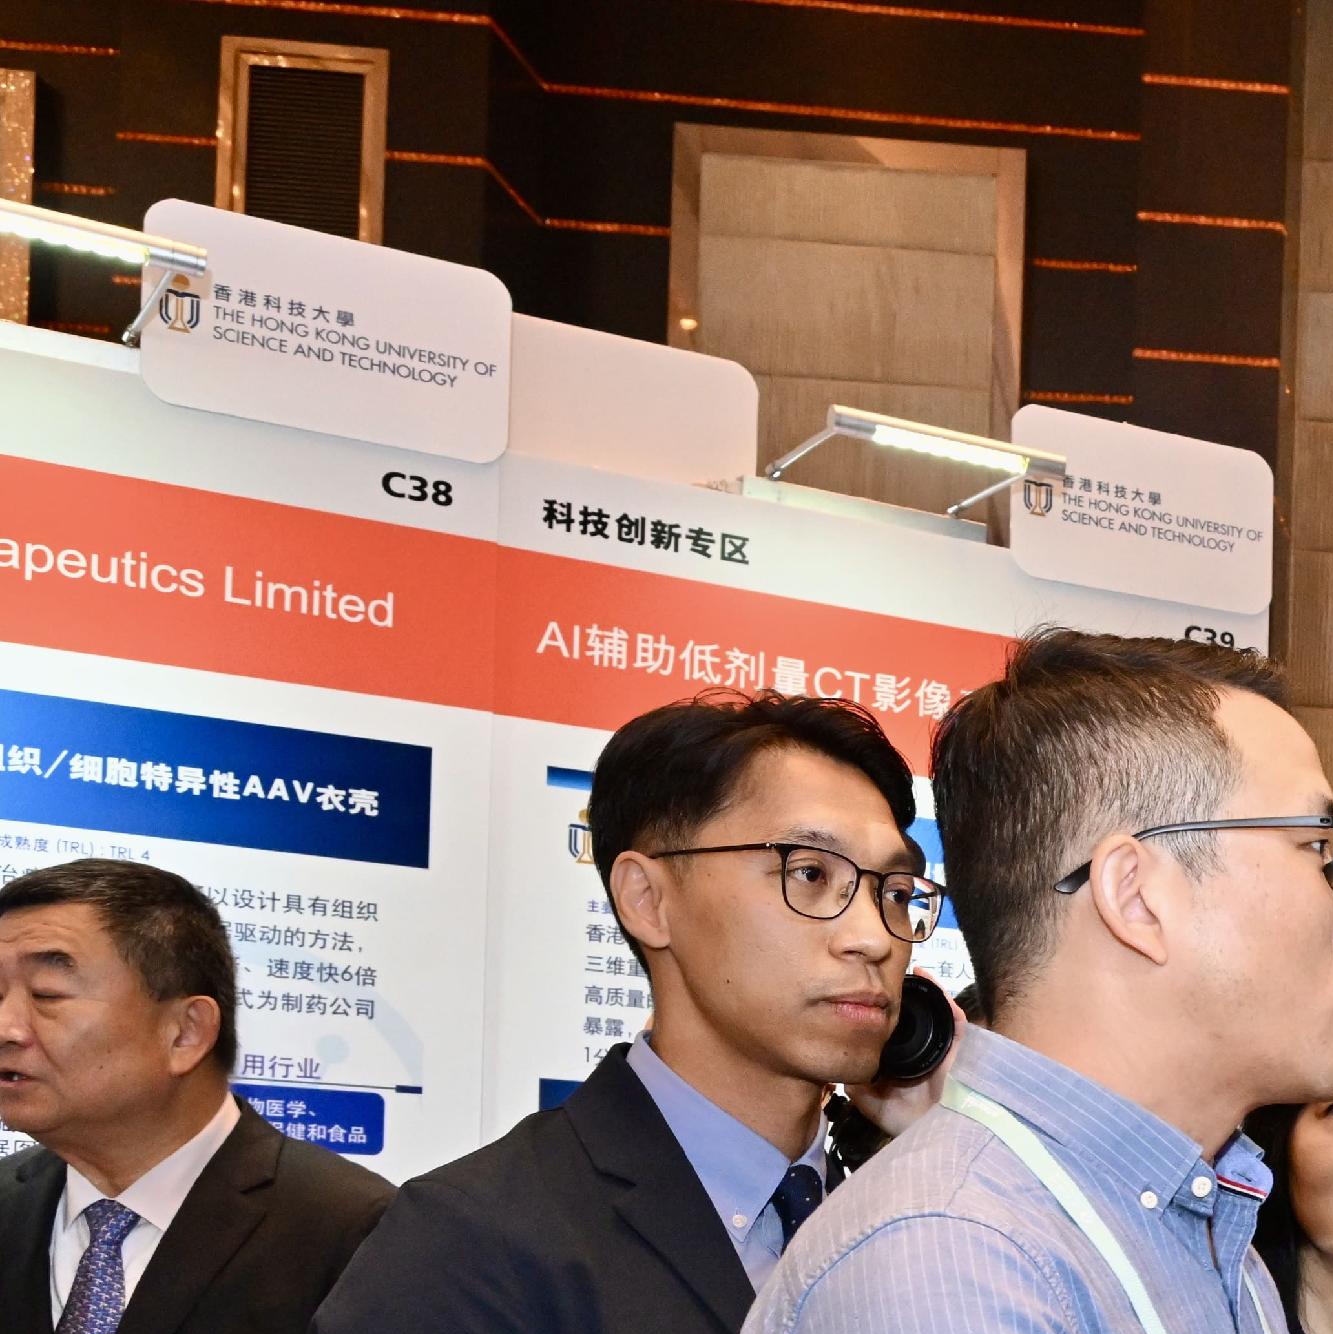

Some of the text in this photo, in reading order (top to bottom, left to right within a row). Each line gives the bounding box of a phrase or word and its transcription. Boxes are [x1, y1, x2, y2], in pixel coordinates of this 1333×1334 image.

[213, 283, 355, 328] 香港科技大學
[212, 326, 459, 388] SCIENCE AND TECHNOLOGY
[213, 306, 498, 377] THE HONG KONG UNIVERSITY OF
[380, 470, 455, 508] C38
[1063, 475, 1163, 506] 香港科技大學
[542, 498, 750, 566] 科技创新专区
[1061, 492, 1264, 542] THE HONG KONG UNIVERSITY OF
[1061, 510, 1236, 553] SCIENCE AND TECHNOLOGY
[0, 537, 396, 629] apeutics Limited
[535, 619, 974, 722] AI辅助低剂量CT影像
[0, 832, 48, 853] 成熟度
[56, 839, 94, 857] (TRL)
[110, 845, 135, 860] TRL
[140, 850, 150, 860] 4
[194, 885, 379, 923] 以设计具有组织
[235, 955, 378, 988] 、速度快6倍
[241, 1053, 322, 1080] 用行业
